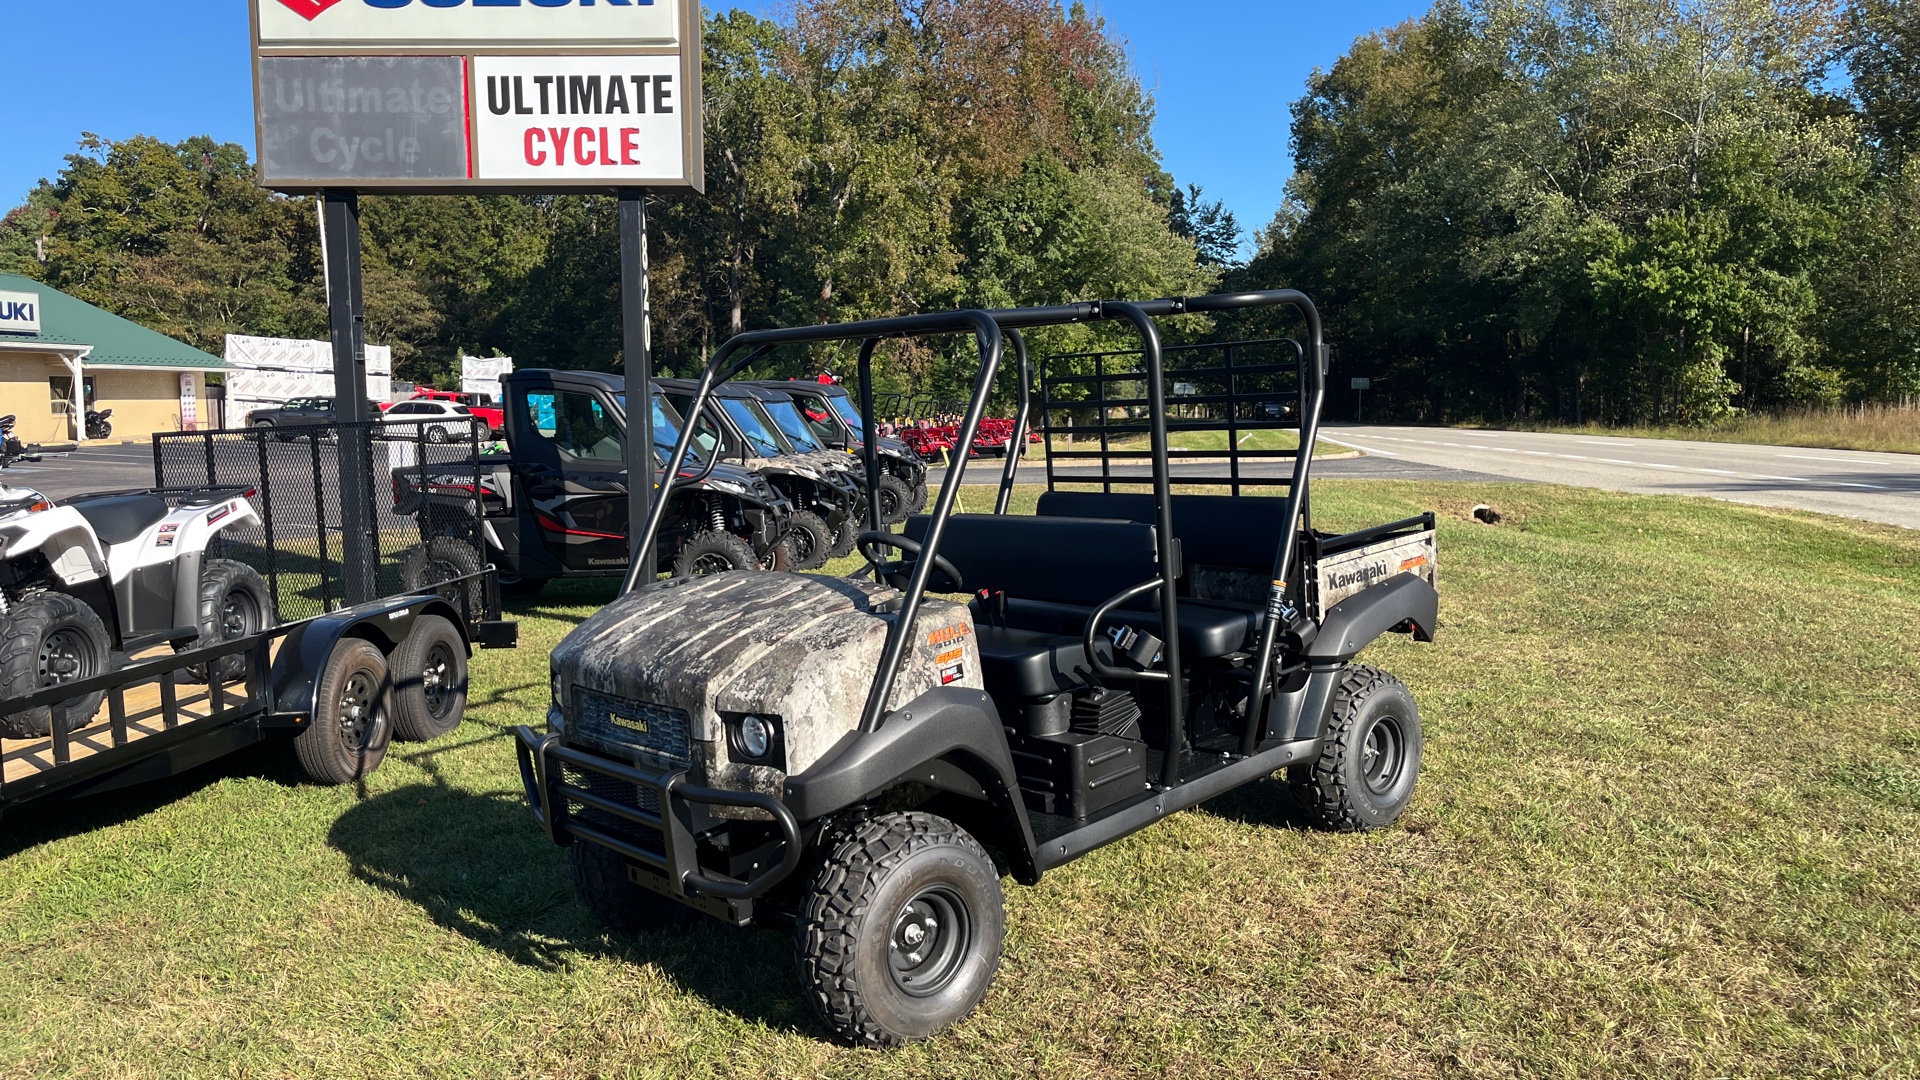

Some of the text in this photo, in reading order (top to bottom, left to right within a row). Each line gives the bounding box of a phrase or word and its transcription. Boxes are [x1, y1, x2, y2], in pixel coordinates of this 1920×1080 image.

[275, 77, 451, 113] Ultimate
[487, 75, 674, 115] ULTIMATE
[310, 127, 421, 171] Cycle
[524, 127, 641, 166] CYCLE
[587, 557, 629, 565] Kawasaki
[1327, 560, 1388, 590] Kawasaki
[926, 622, 972, 647] MULE
[935, 636, 965, 649] 4010
[610, 712, 648, 733] Kawasaki
